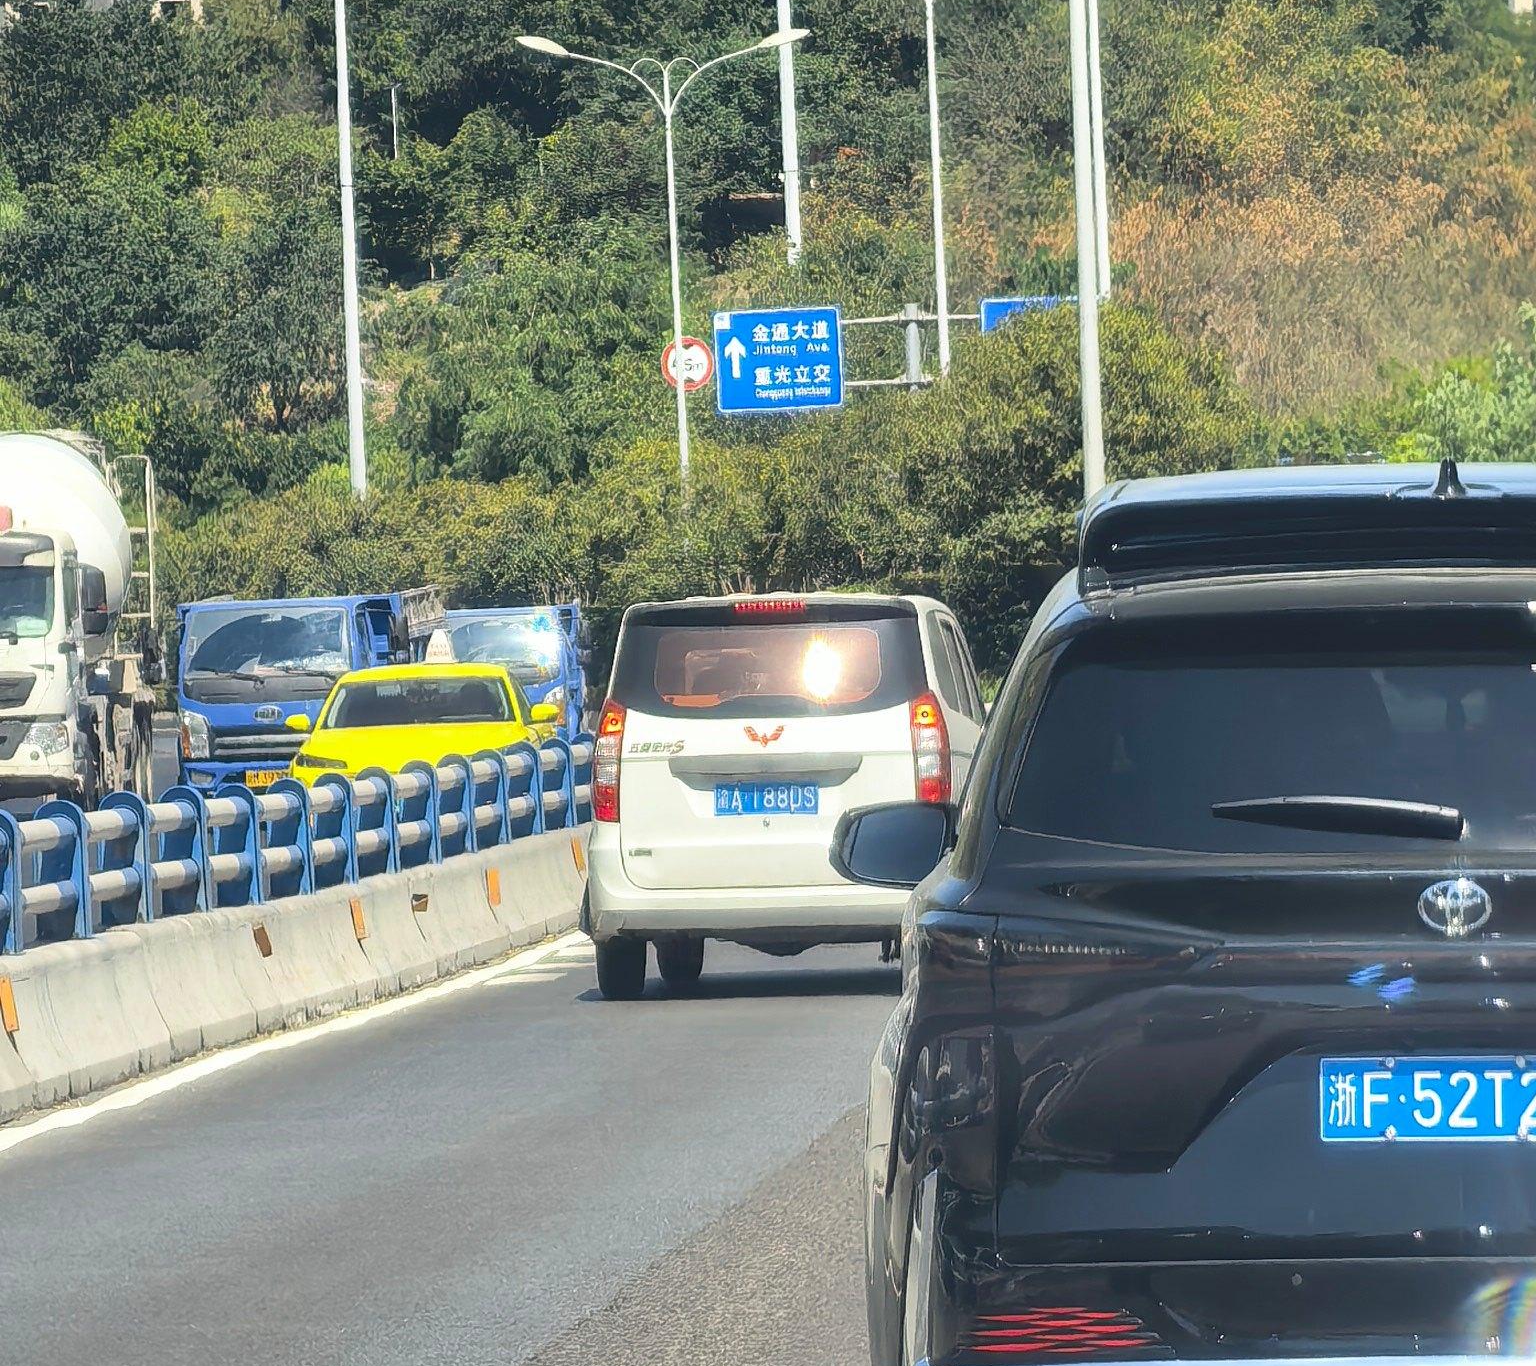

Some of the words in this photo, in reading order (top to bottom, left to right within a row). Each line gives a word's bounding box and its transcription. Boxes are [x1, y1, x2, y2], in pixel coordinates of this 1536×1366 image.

[752, 320, 830, 342] 金通大道
[754, 363, 832, 386] 重光立交
